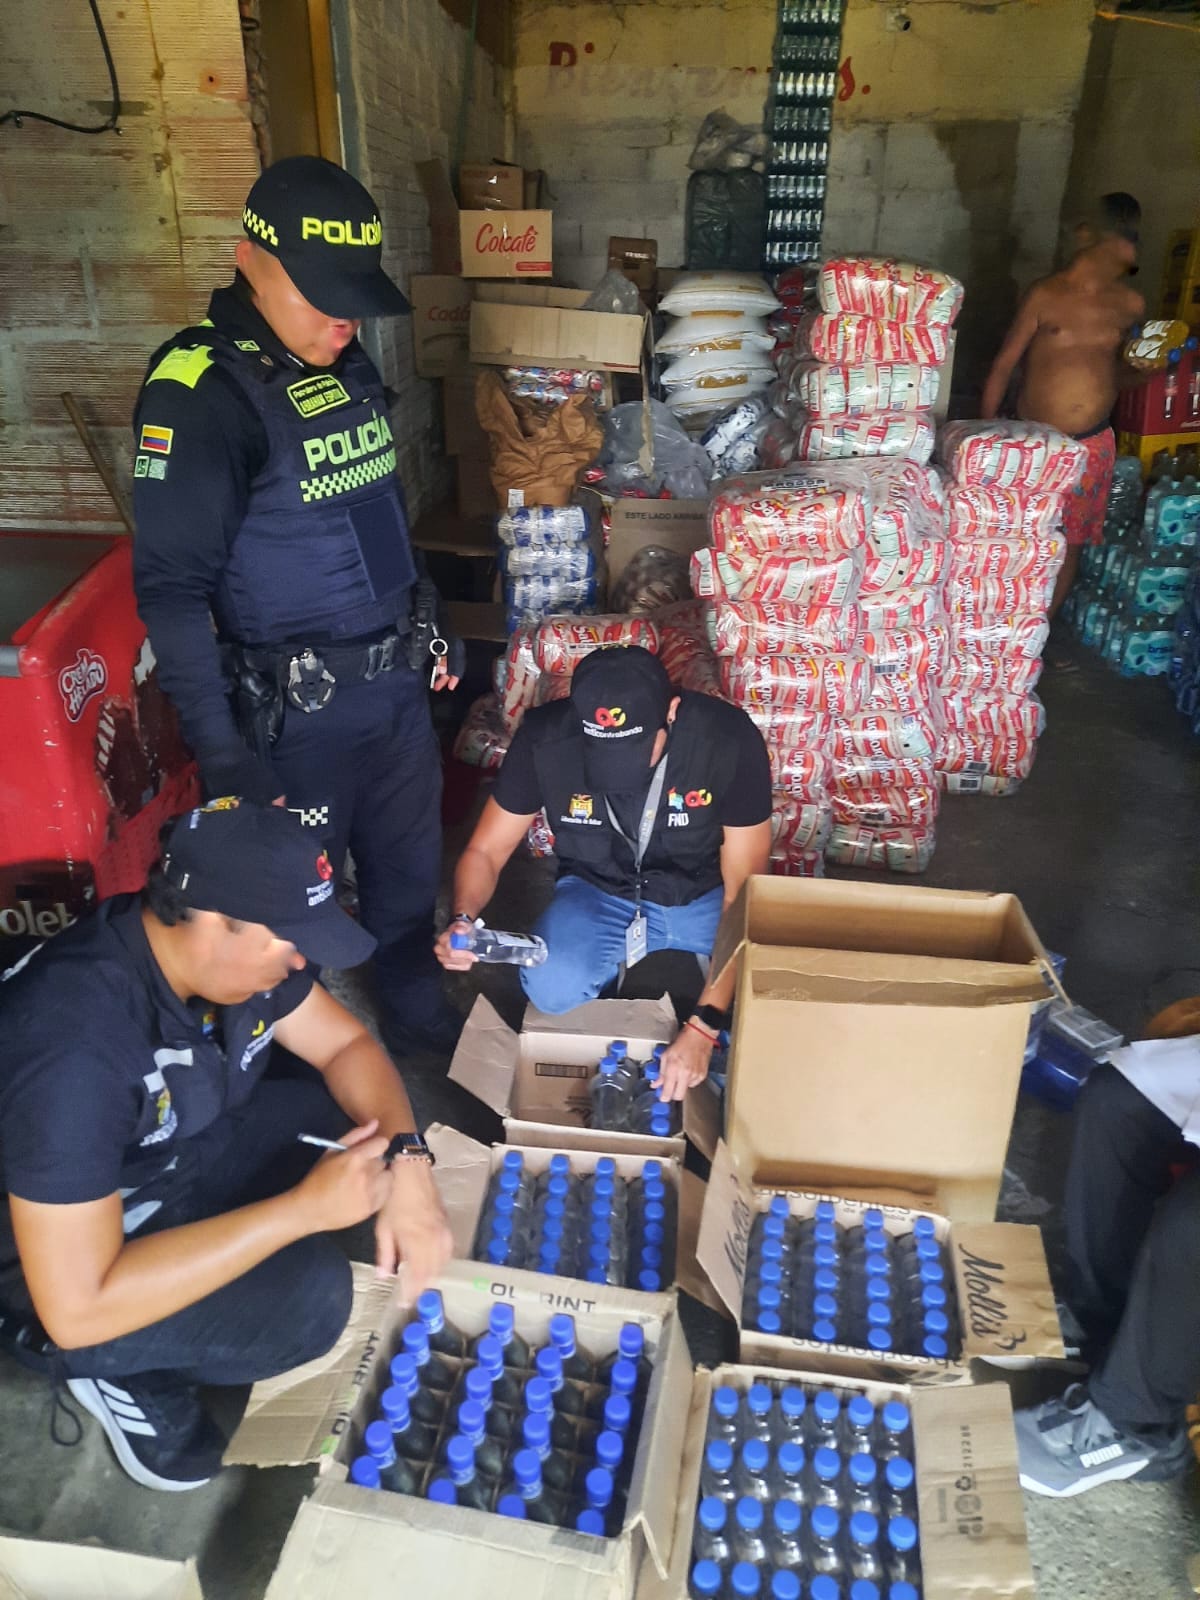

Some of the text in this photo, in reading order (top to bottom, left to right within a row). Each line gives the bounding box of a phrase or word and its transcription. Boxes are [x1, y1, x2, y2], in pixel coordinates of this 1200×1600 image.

[303, 407, 393, 472] POLICÍA
[625, 511, 648, 520] ESTE
[667, 812, 690, 828] FND
